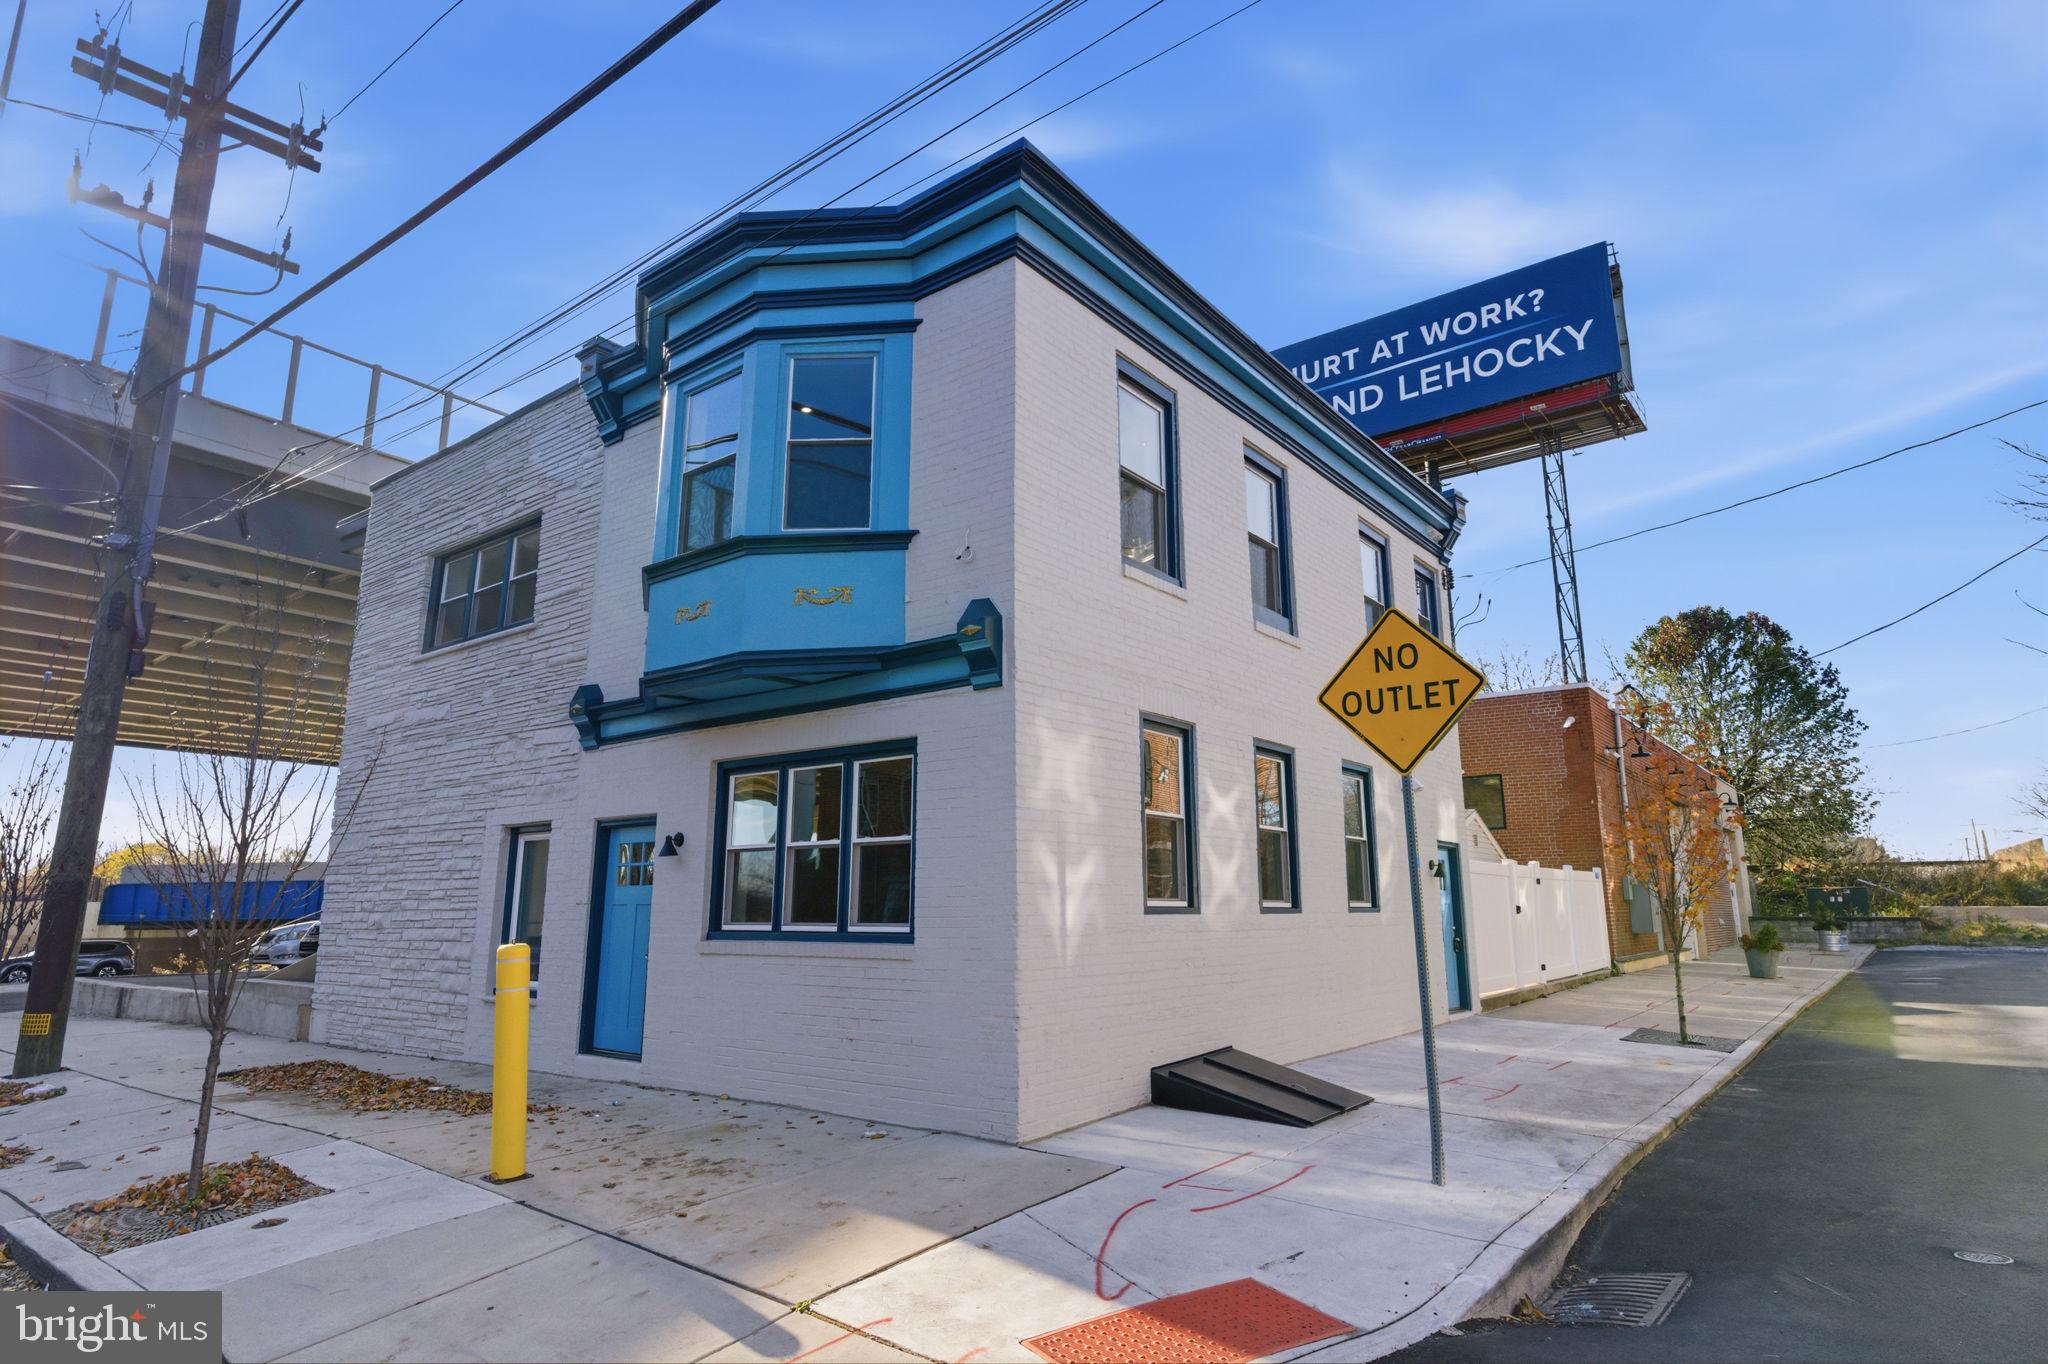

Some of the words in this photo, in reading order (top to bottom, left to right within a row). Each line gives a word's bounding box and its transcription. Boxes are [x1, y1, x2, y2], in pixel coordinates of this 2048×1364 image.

[1370, 331, 1409, 364] AT
[1420, 288, 1545, 346] WORK?
[1332, 384, 1384, 416] ND
[1398, 318, 1594, 402] LEHOCKY
[1373, 643, 1419, 673] NO
[1341, 679, 1460, 717] OUTLET
